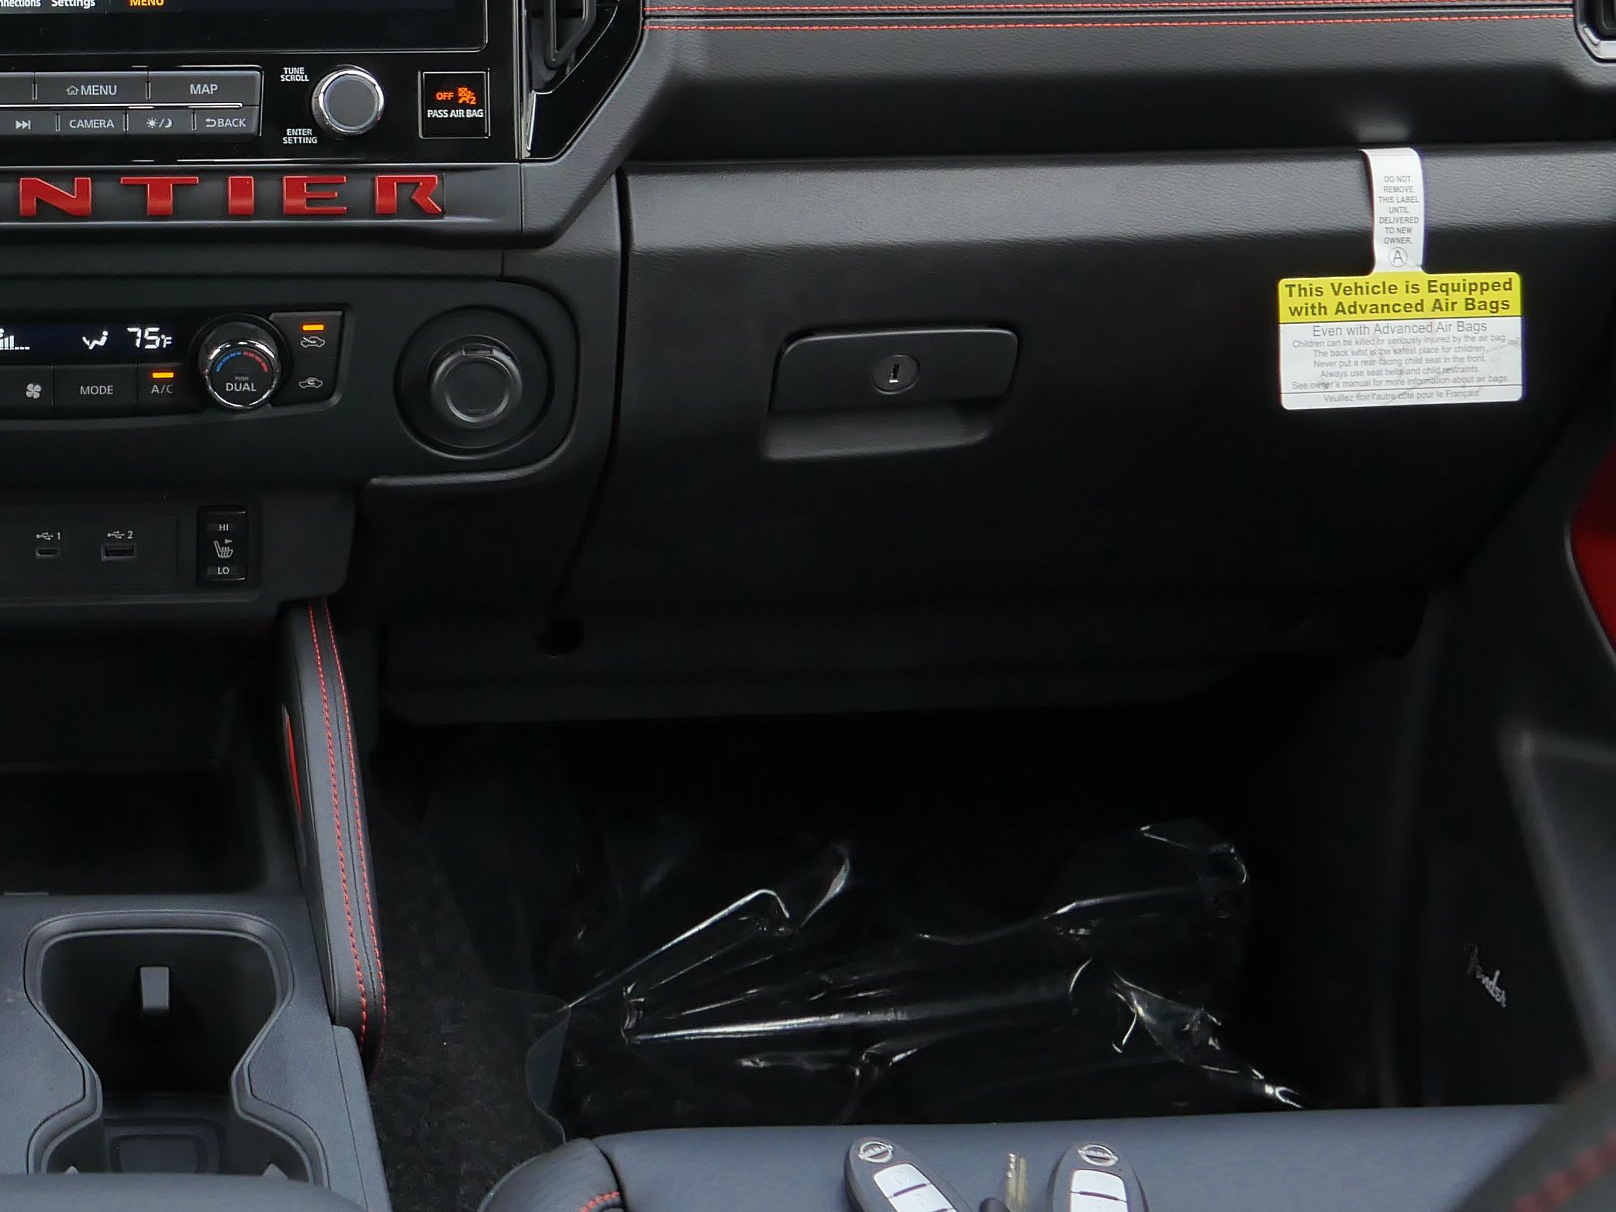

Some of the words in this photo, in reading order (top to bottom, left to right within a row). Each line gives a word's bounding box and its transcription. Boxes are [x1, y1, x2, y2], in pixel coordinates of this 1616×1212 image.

[284, 67, 305, 75] TUNE
[280, 74, 310, 82] SCROLL
[80, 85, 117, 96] MENU
[190, 84, 218, 95] MAP
[436, 92, 454, 100] OFF
[427, 109, 449, 118] PASS
[450, 109, 465, 118] AIR
[466, 109, 484, 118] BAG
[69, 119, 115, 129] CAMERA
[217, 118, 246, 128] BACK
[282, 136, 318, 144] SETTING
[1396, 175, 1411, 183] NOT
[1378, 196, 1395, 204] THIS
[1396, 196, 1420, 204] LABEL
[1389, 206, 1410, 214] UNTIL
[1393, 250, 1404, 264] A
[1285, 284, 1324, 298] This
[1330, 281, 1398, 296] Vehicle
[1405, 280, 1420, 294] is
[1427, 278, 1513, 296] Equipped
[1289, 302, 1328, 317] with
[1334, 299, 1424, 316] Advanced
[1431, 298, 1458, 312] Air
[1464, 297, 1510, 314] Bags
[1313, 325, 1342, 337] Even
[1346, 324, 1370, 336] with
[1374, 322, 1432, 335] Advanced
[1436, 321, 1452, 332] Air
[1456, 320, 1488, 334] Bags
[1292, 340, 1324, 348] Children
[1344, 338, 1352, 346] be
[1313, 349, 1328, 358] The
[1330, 349, 1349, 357] back
[80, 385, 114, 395] MODE
[150, 384, 173, 394] A/C
[225, 382, 257, 392] DUAL
[218, 523, 229, 532] HI
[57, 532, 61, 541] 1
[128, 530, 134, 539] 2
[217, 566, 230, 575] LO
